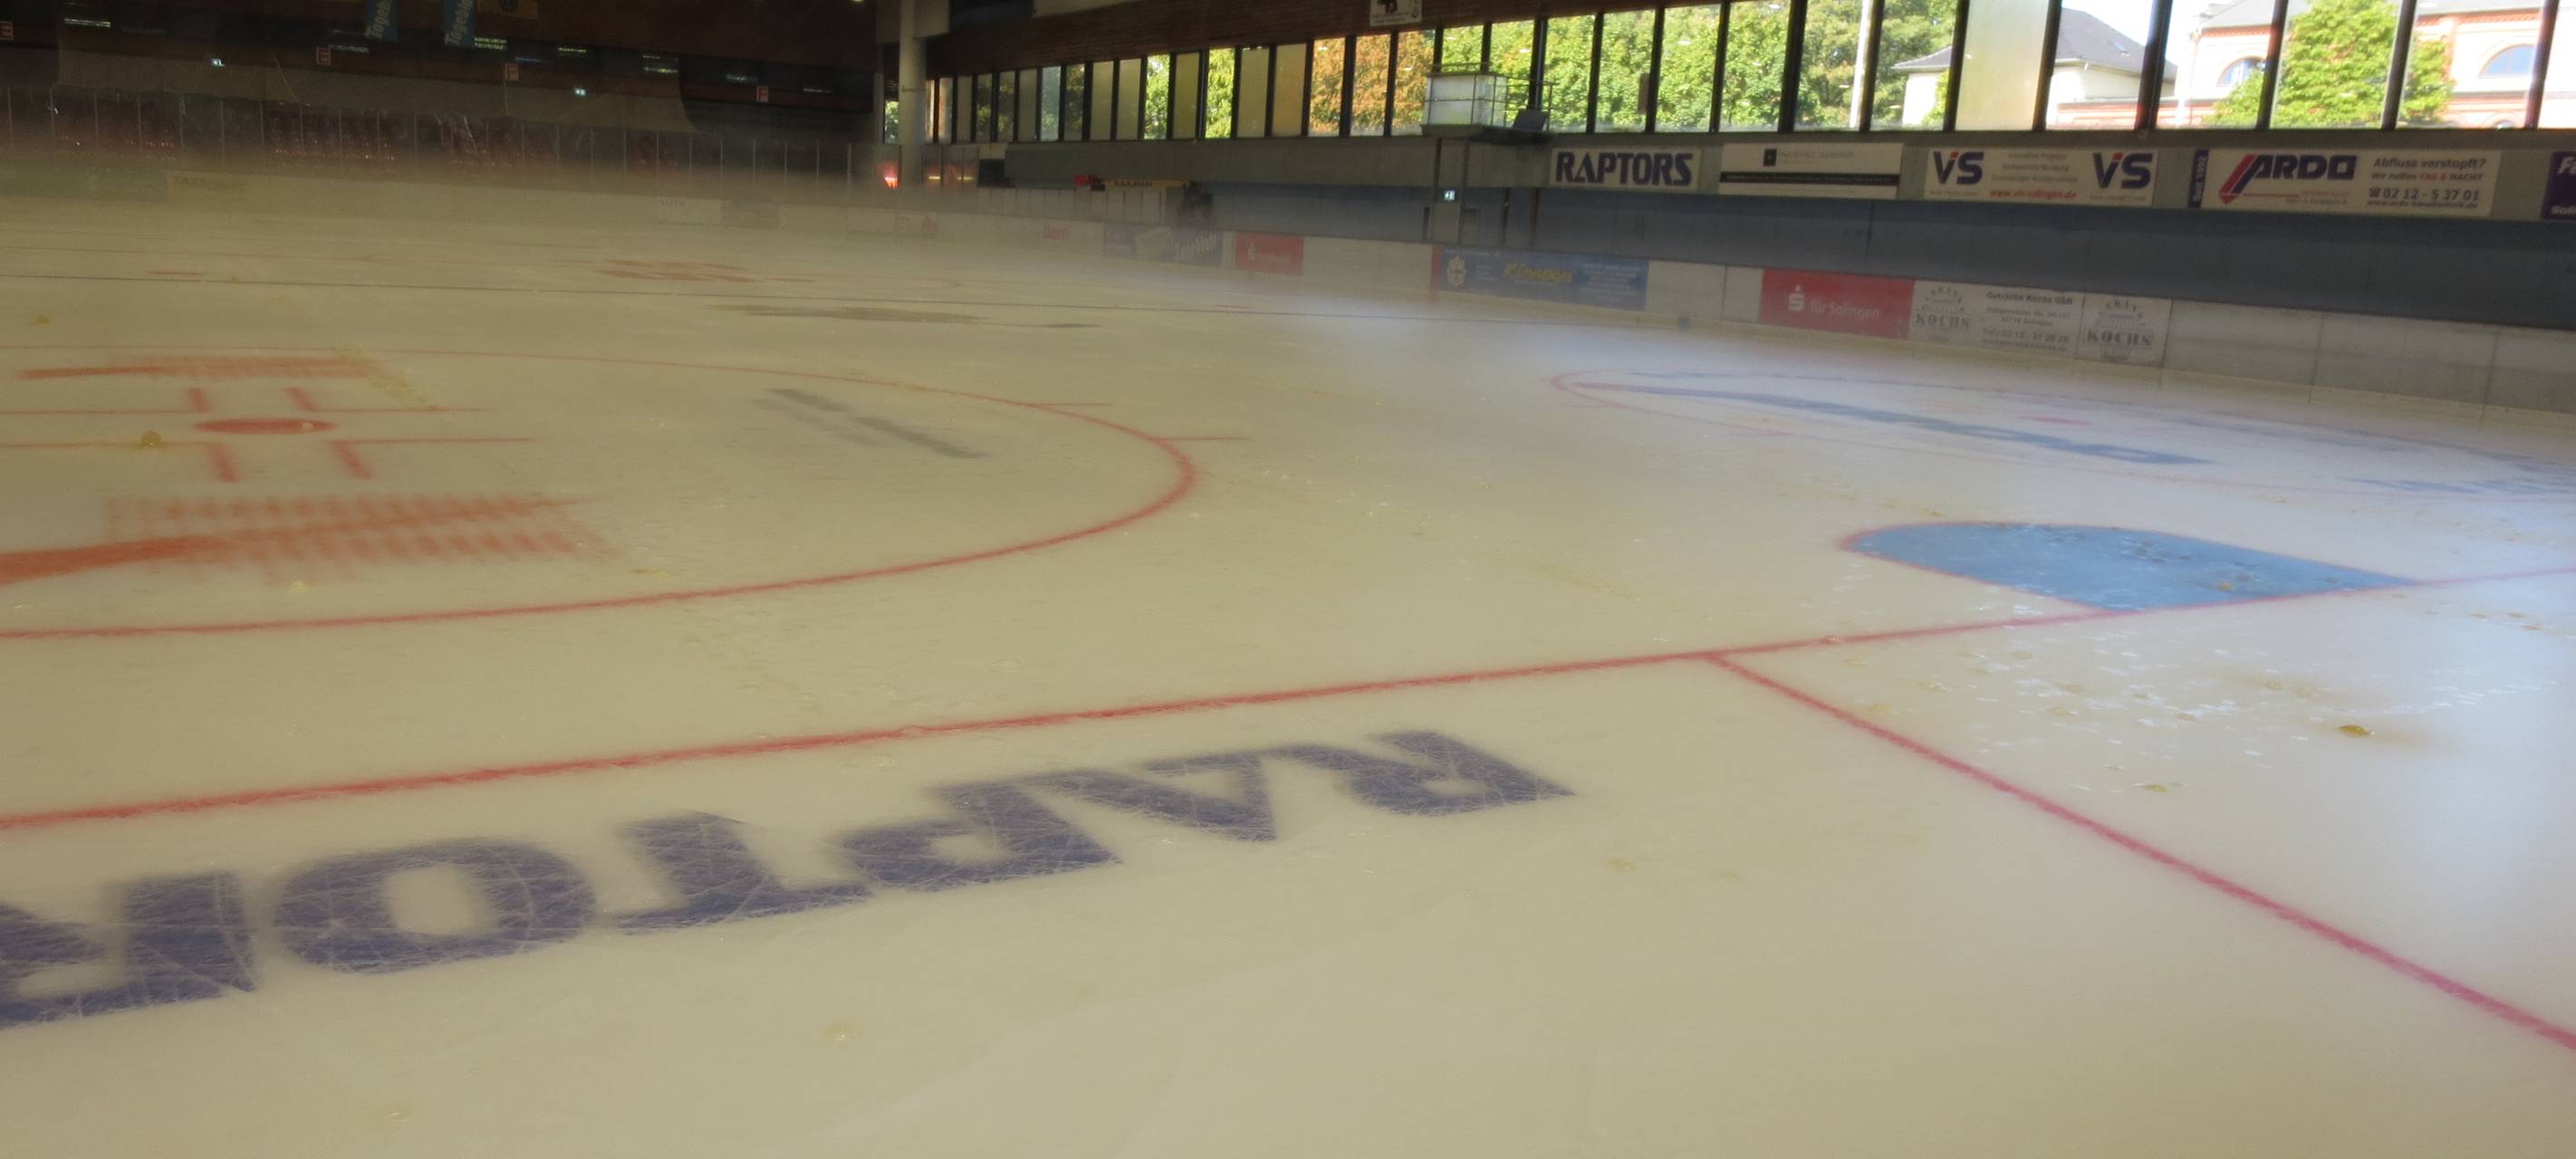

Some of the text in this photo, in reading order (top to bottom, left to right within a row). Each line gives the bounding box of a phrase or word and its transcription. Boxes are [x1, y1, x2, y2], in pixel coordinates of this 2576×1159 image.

[1555, 151, 1694, 187] RAPTORS
[2373, 157, 2486, 170] Abfluss verstopft?
[2232, 154, 2358, 194] ARDO
[2383, 187, 2399, 198] 02
[2403, 188, 2419, 199] 12
[2430, 188, 2439, 200] 5
[2443, 188, 2459, 200] 37
[2462, 189, 2479, 201] 01
[1811, 299, 1880, 321] für Solingen
[1916, 313, 1969, 328] KOCHS
[2086, 329, 2152, 347] KOCHS
